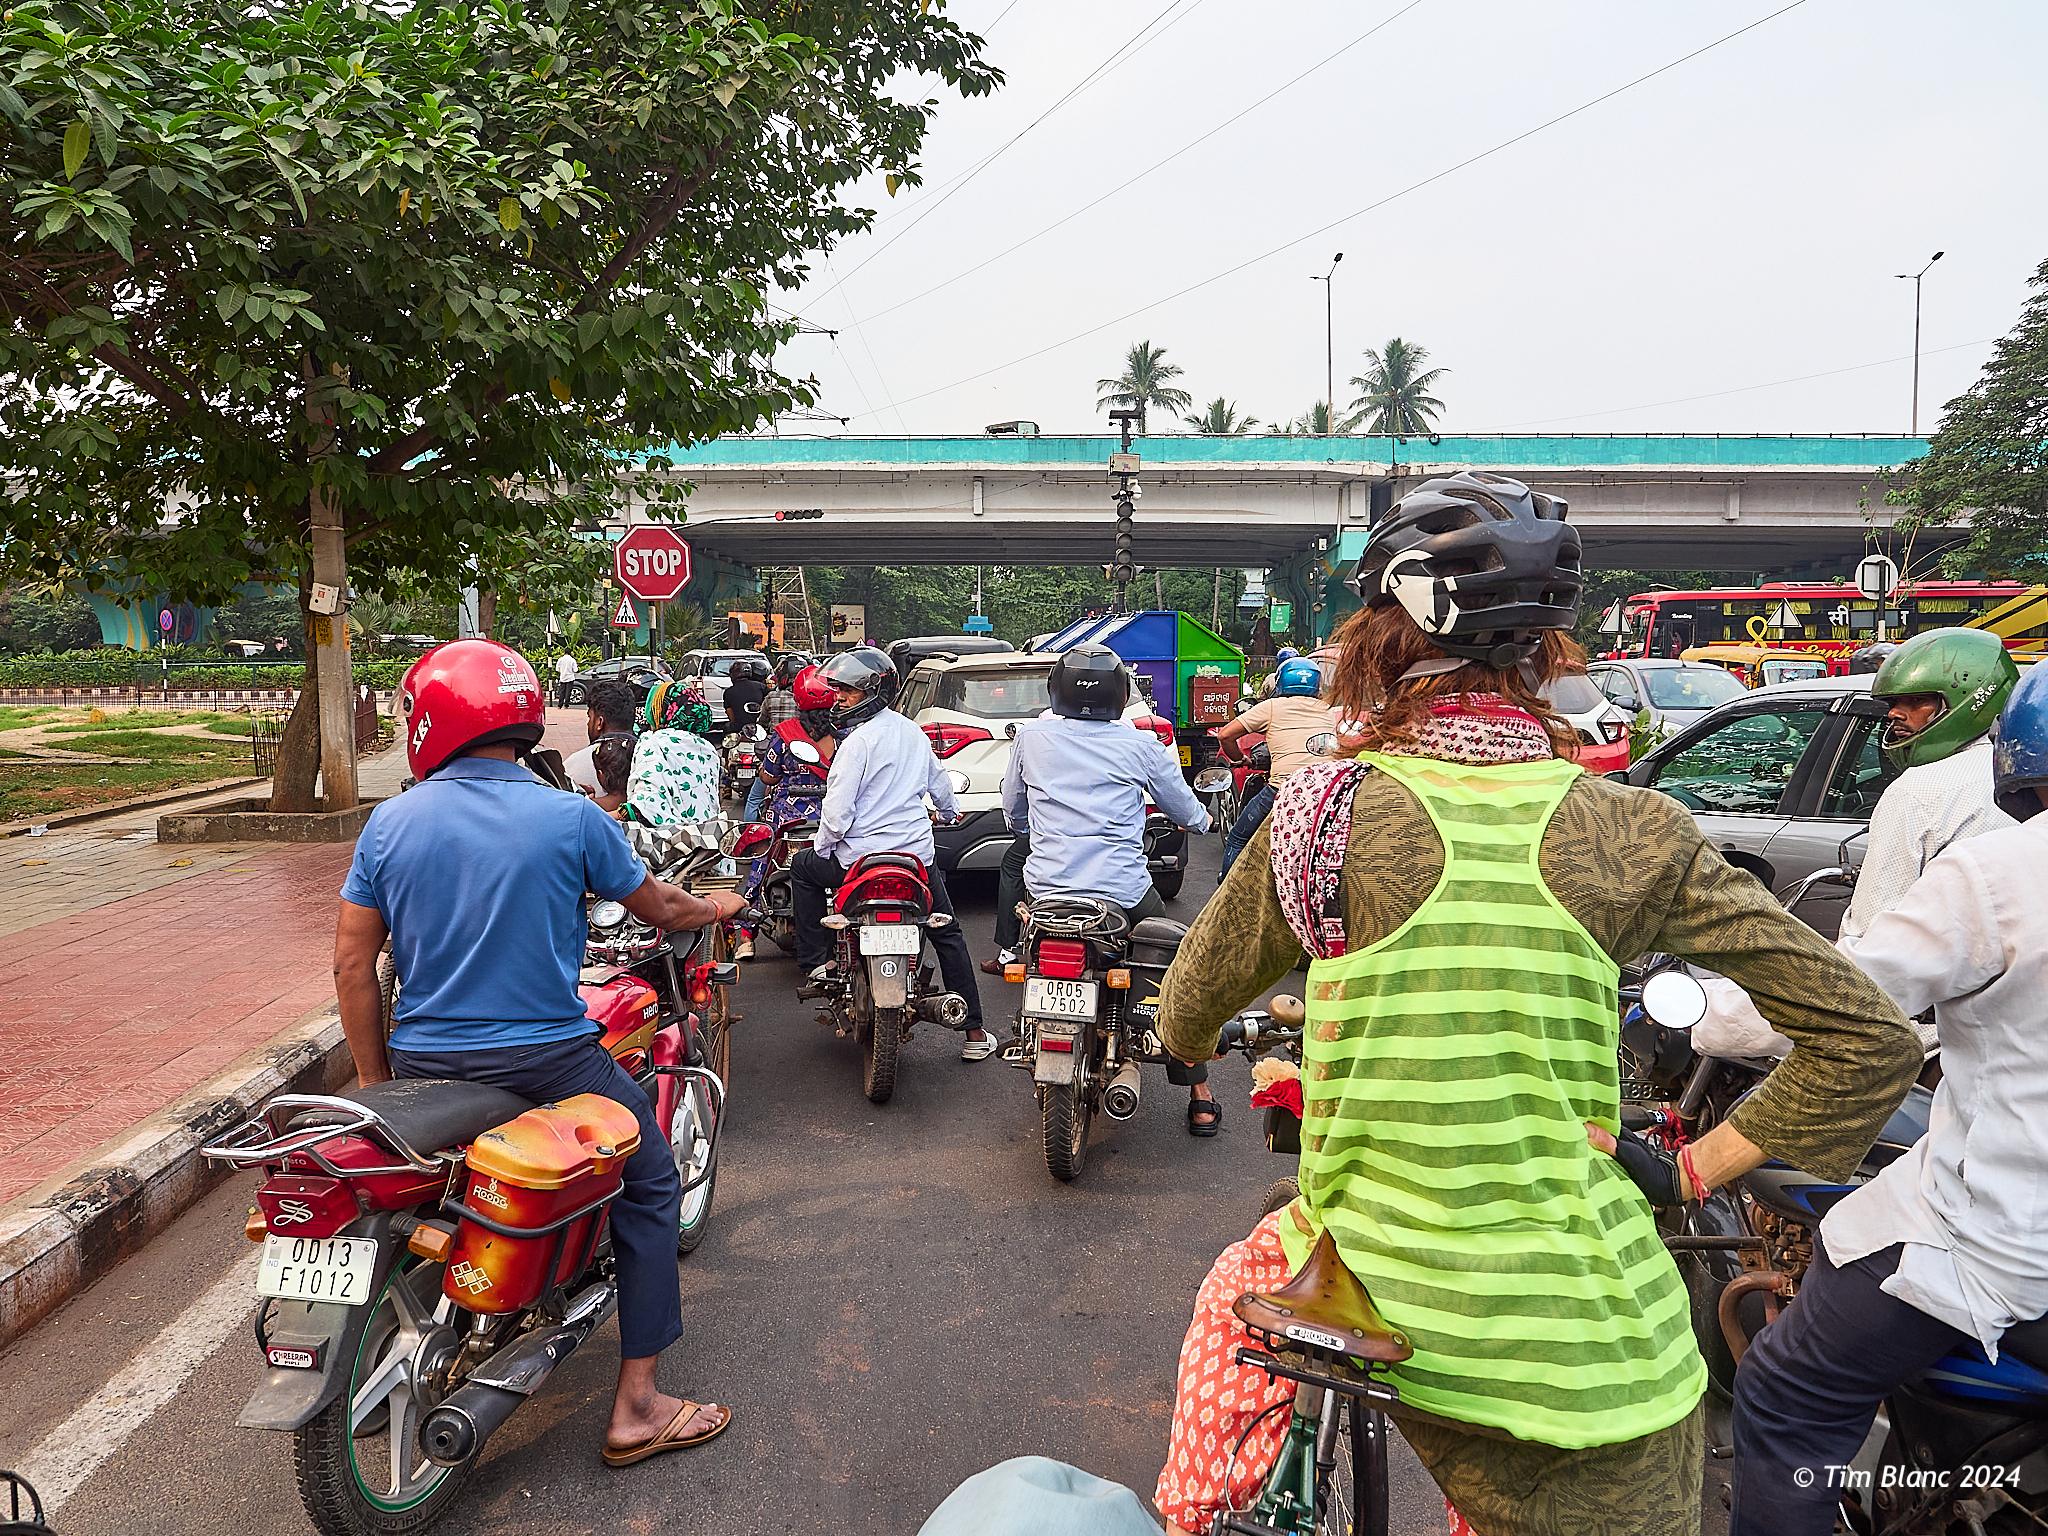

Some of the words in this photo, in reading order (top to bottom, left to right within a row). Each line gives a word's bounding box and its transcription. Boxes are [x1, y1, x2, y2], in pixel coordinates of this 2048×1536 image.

[625, 548, 682, 576] STOP
[642, 1002, 659, 1020] Hero
[1040, 995, 1086, 1014] L7502
[1136, 1004, 1157, 1012] HER
[288, 1158, 307, 1166] ero
[278, 1266, 354, 1298] F1012
[272, 1351, 309, 1363] SHREERAM
